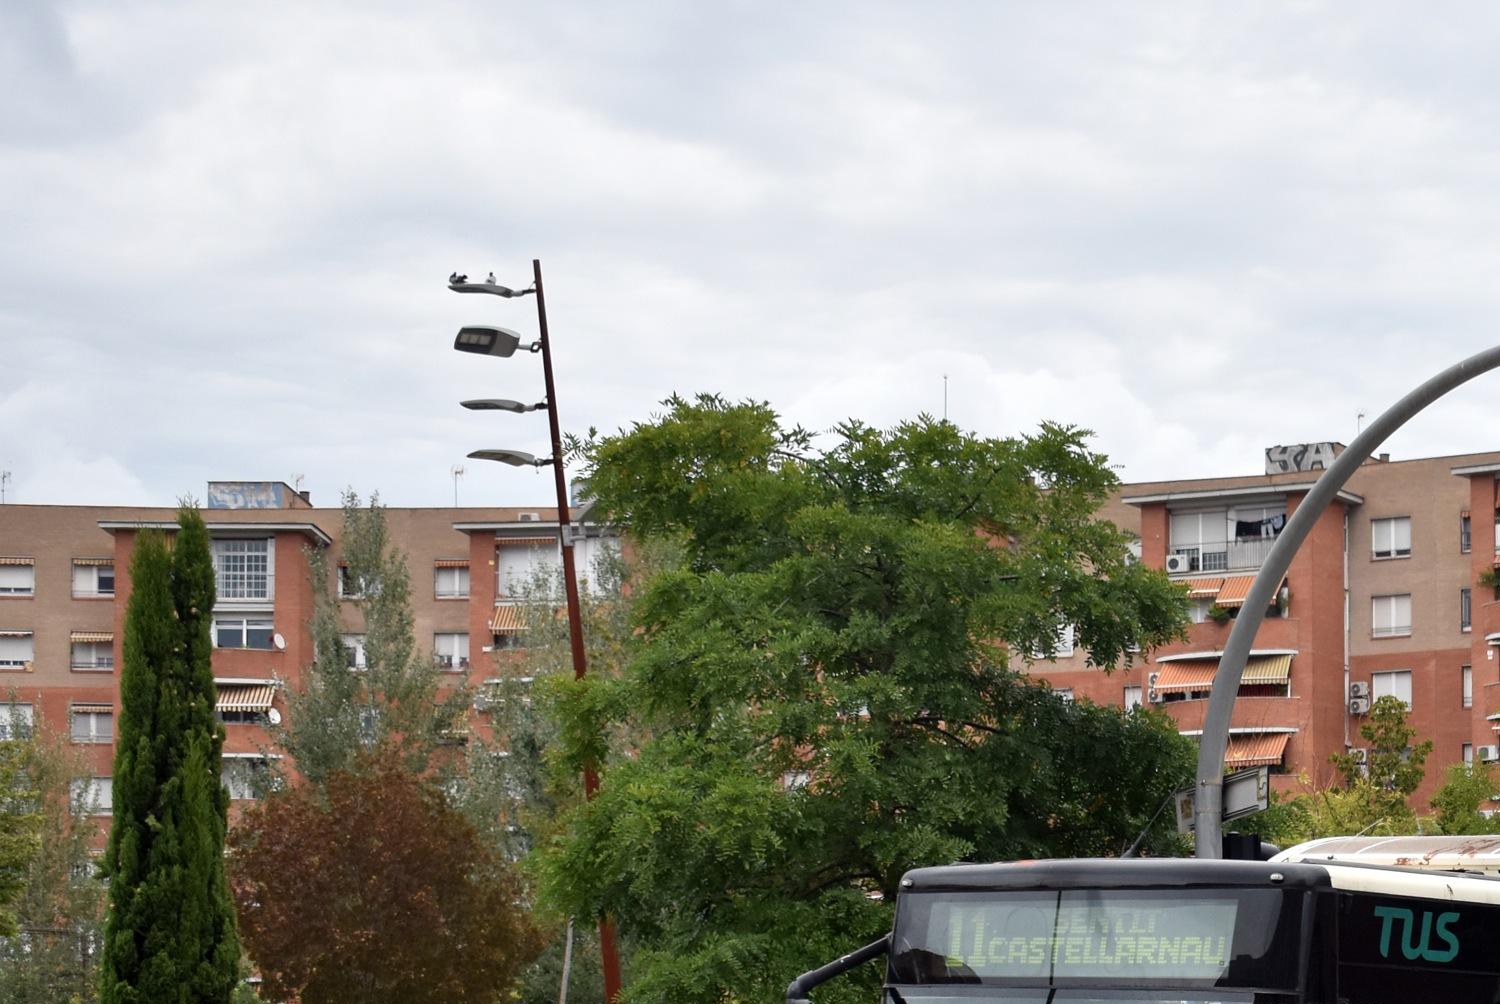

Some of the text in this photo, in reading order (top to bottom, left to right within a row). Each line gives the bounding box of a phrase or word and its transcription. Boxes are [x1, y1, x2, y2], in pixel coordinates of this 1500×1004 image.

[945, 906, 987, 966] 11
[988, 936, 1226, 965] CASTELLARNAU
[1373, 905, 1461, 963] TUS
